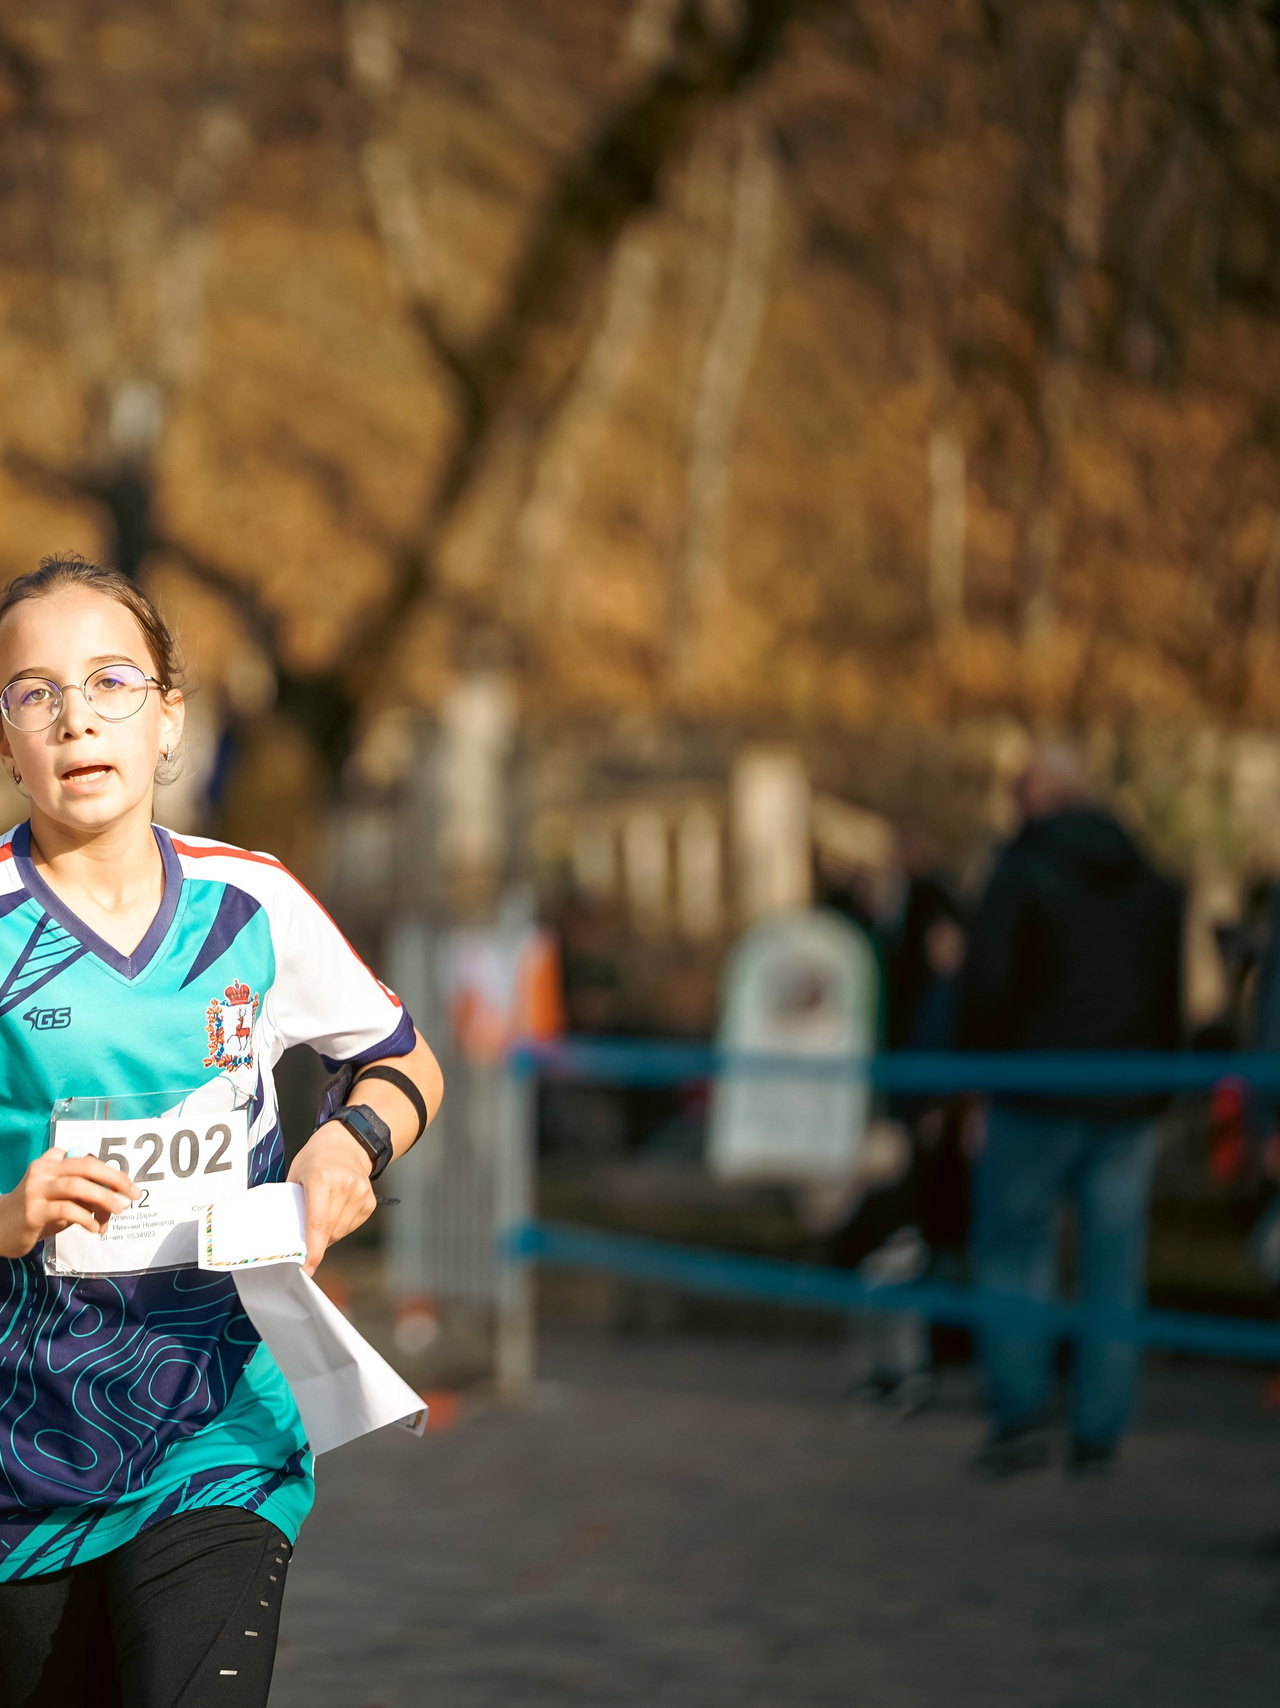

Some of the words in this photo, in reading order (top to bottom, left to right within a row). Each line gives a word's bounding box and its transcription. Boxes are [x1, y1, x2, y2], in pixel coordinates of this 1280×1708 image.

[98, 1123, 232, 1183] 5202
[136, 1212, 158, 1220] Дарья
[143, 1220, 175, 1229] Новгород
[127, 1230, 156, 1239] 8534923
